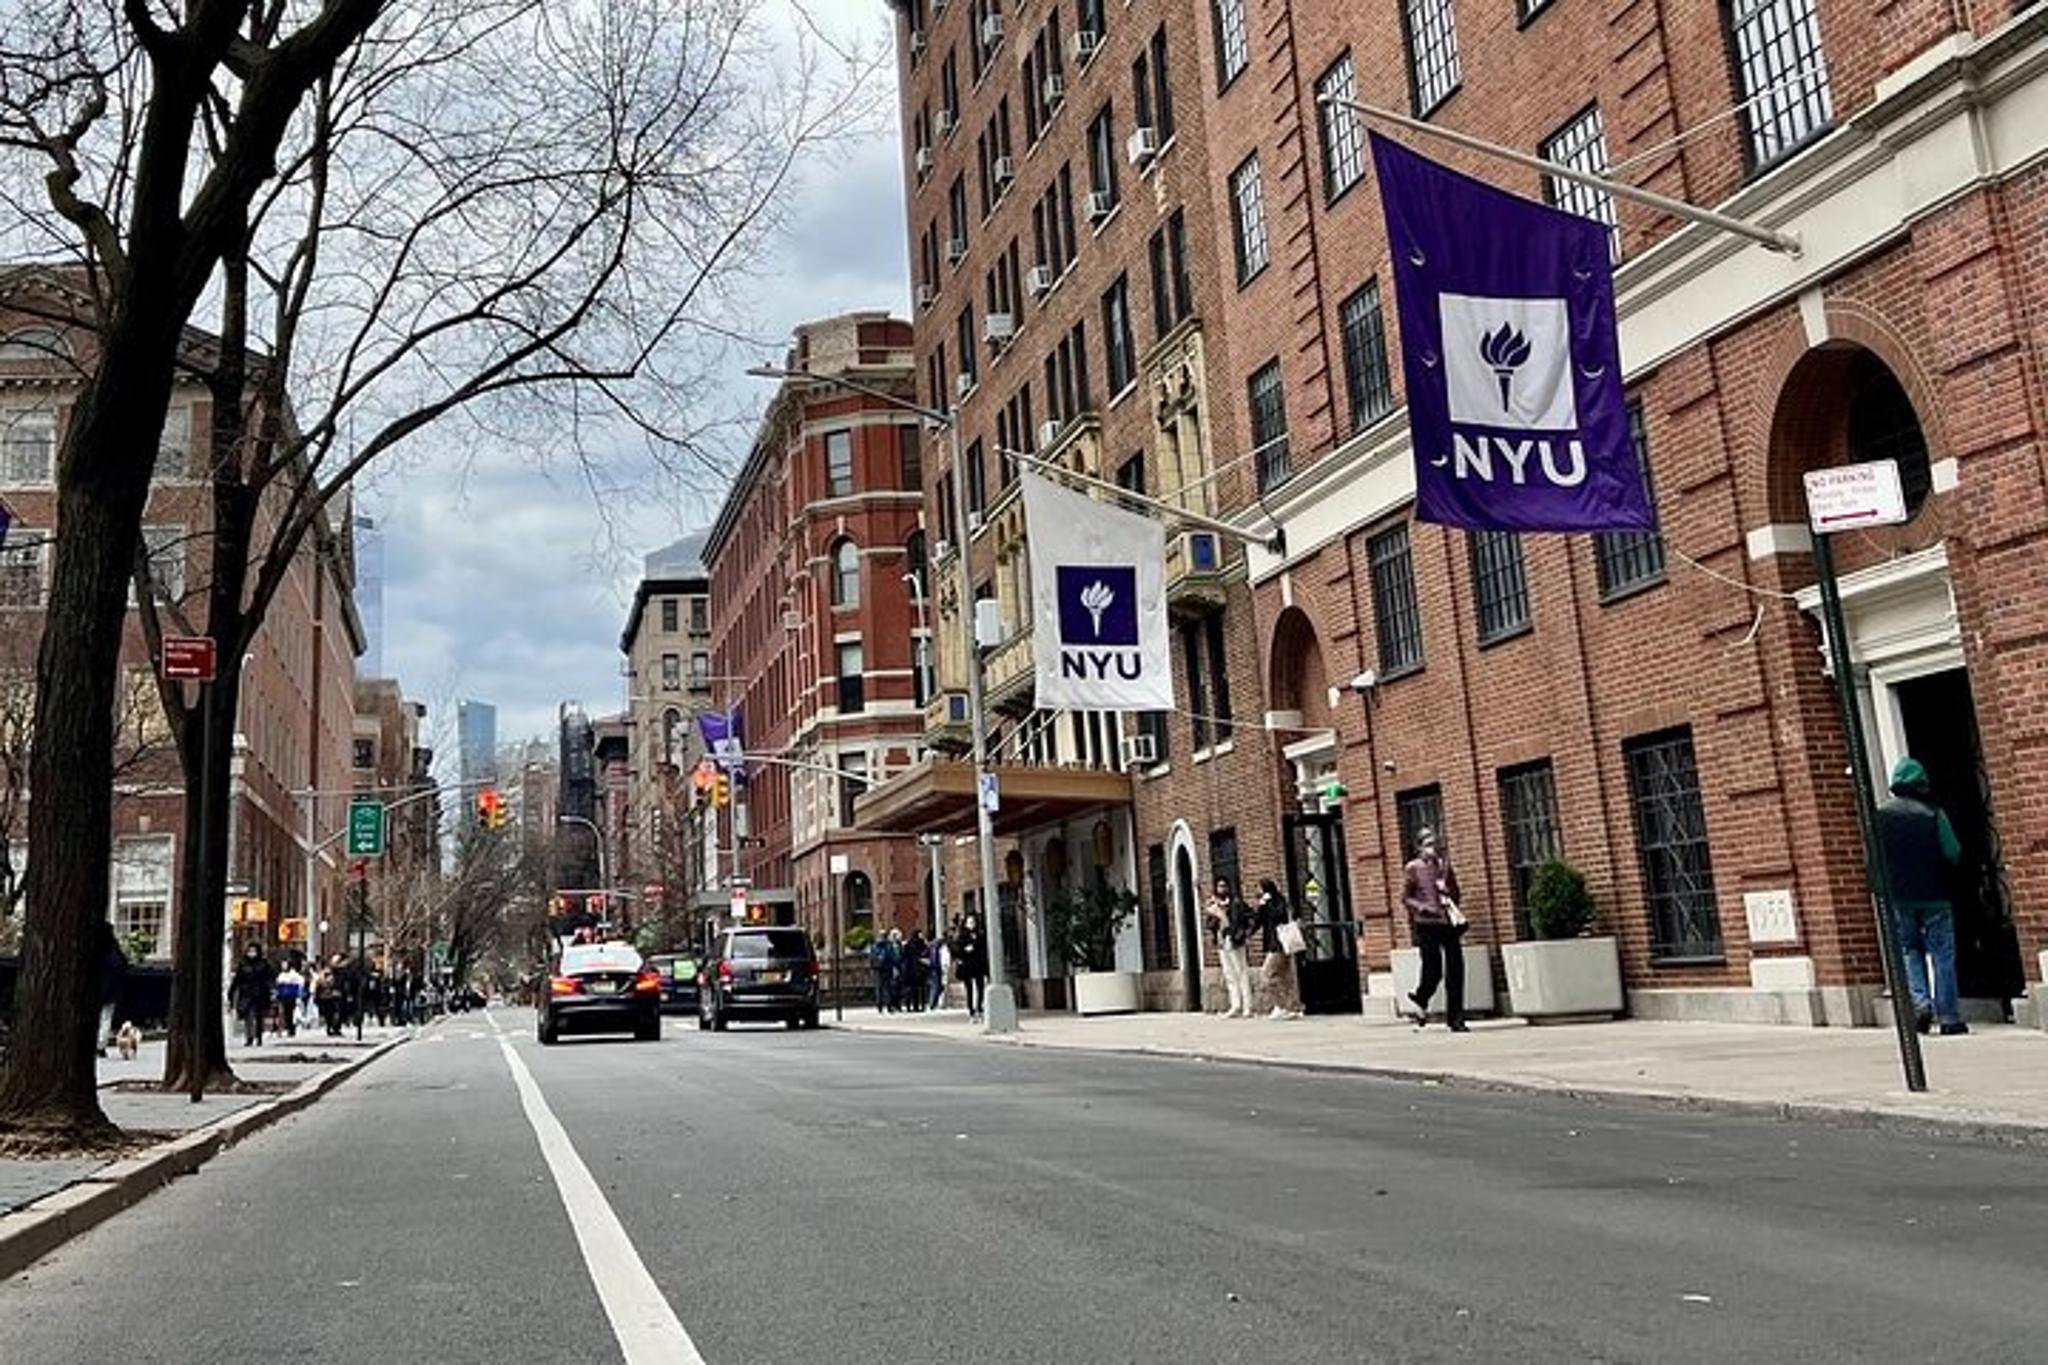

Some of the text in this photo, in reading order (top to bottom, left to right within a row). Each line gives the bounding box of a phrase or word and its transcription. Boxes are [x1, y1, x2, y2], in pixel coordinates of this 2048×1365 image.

[1452, 432, 1587, 486] NYU
[1811, 468, 1876, 488] NO PARKING
[1061, 651, 1142, 681] NYU
